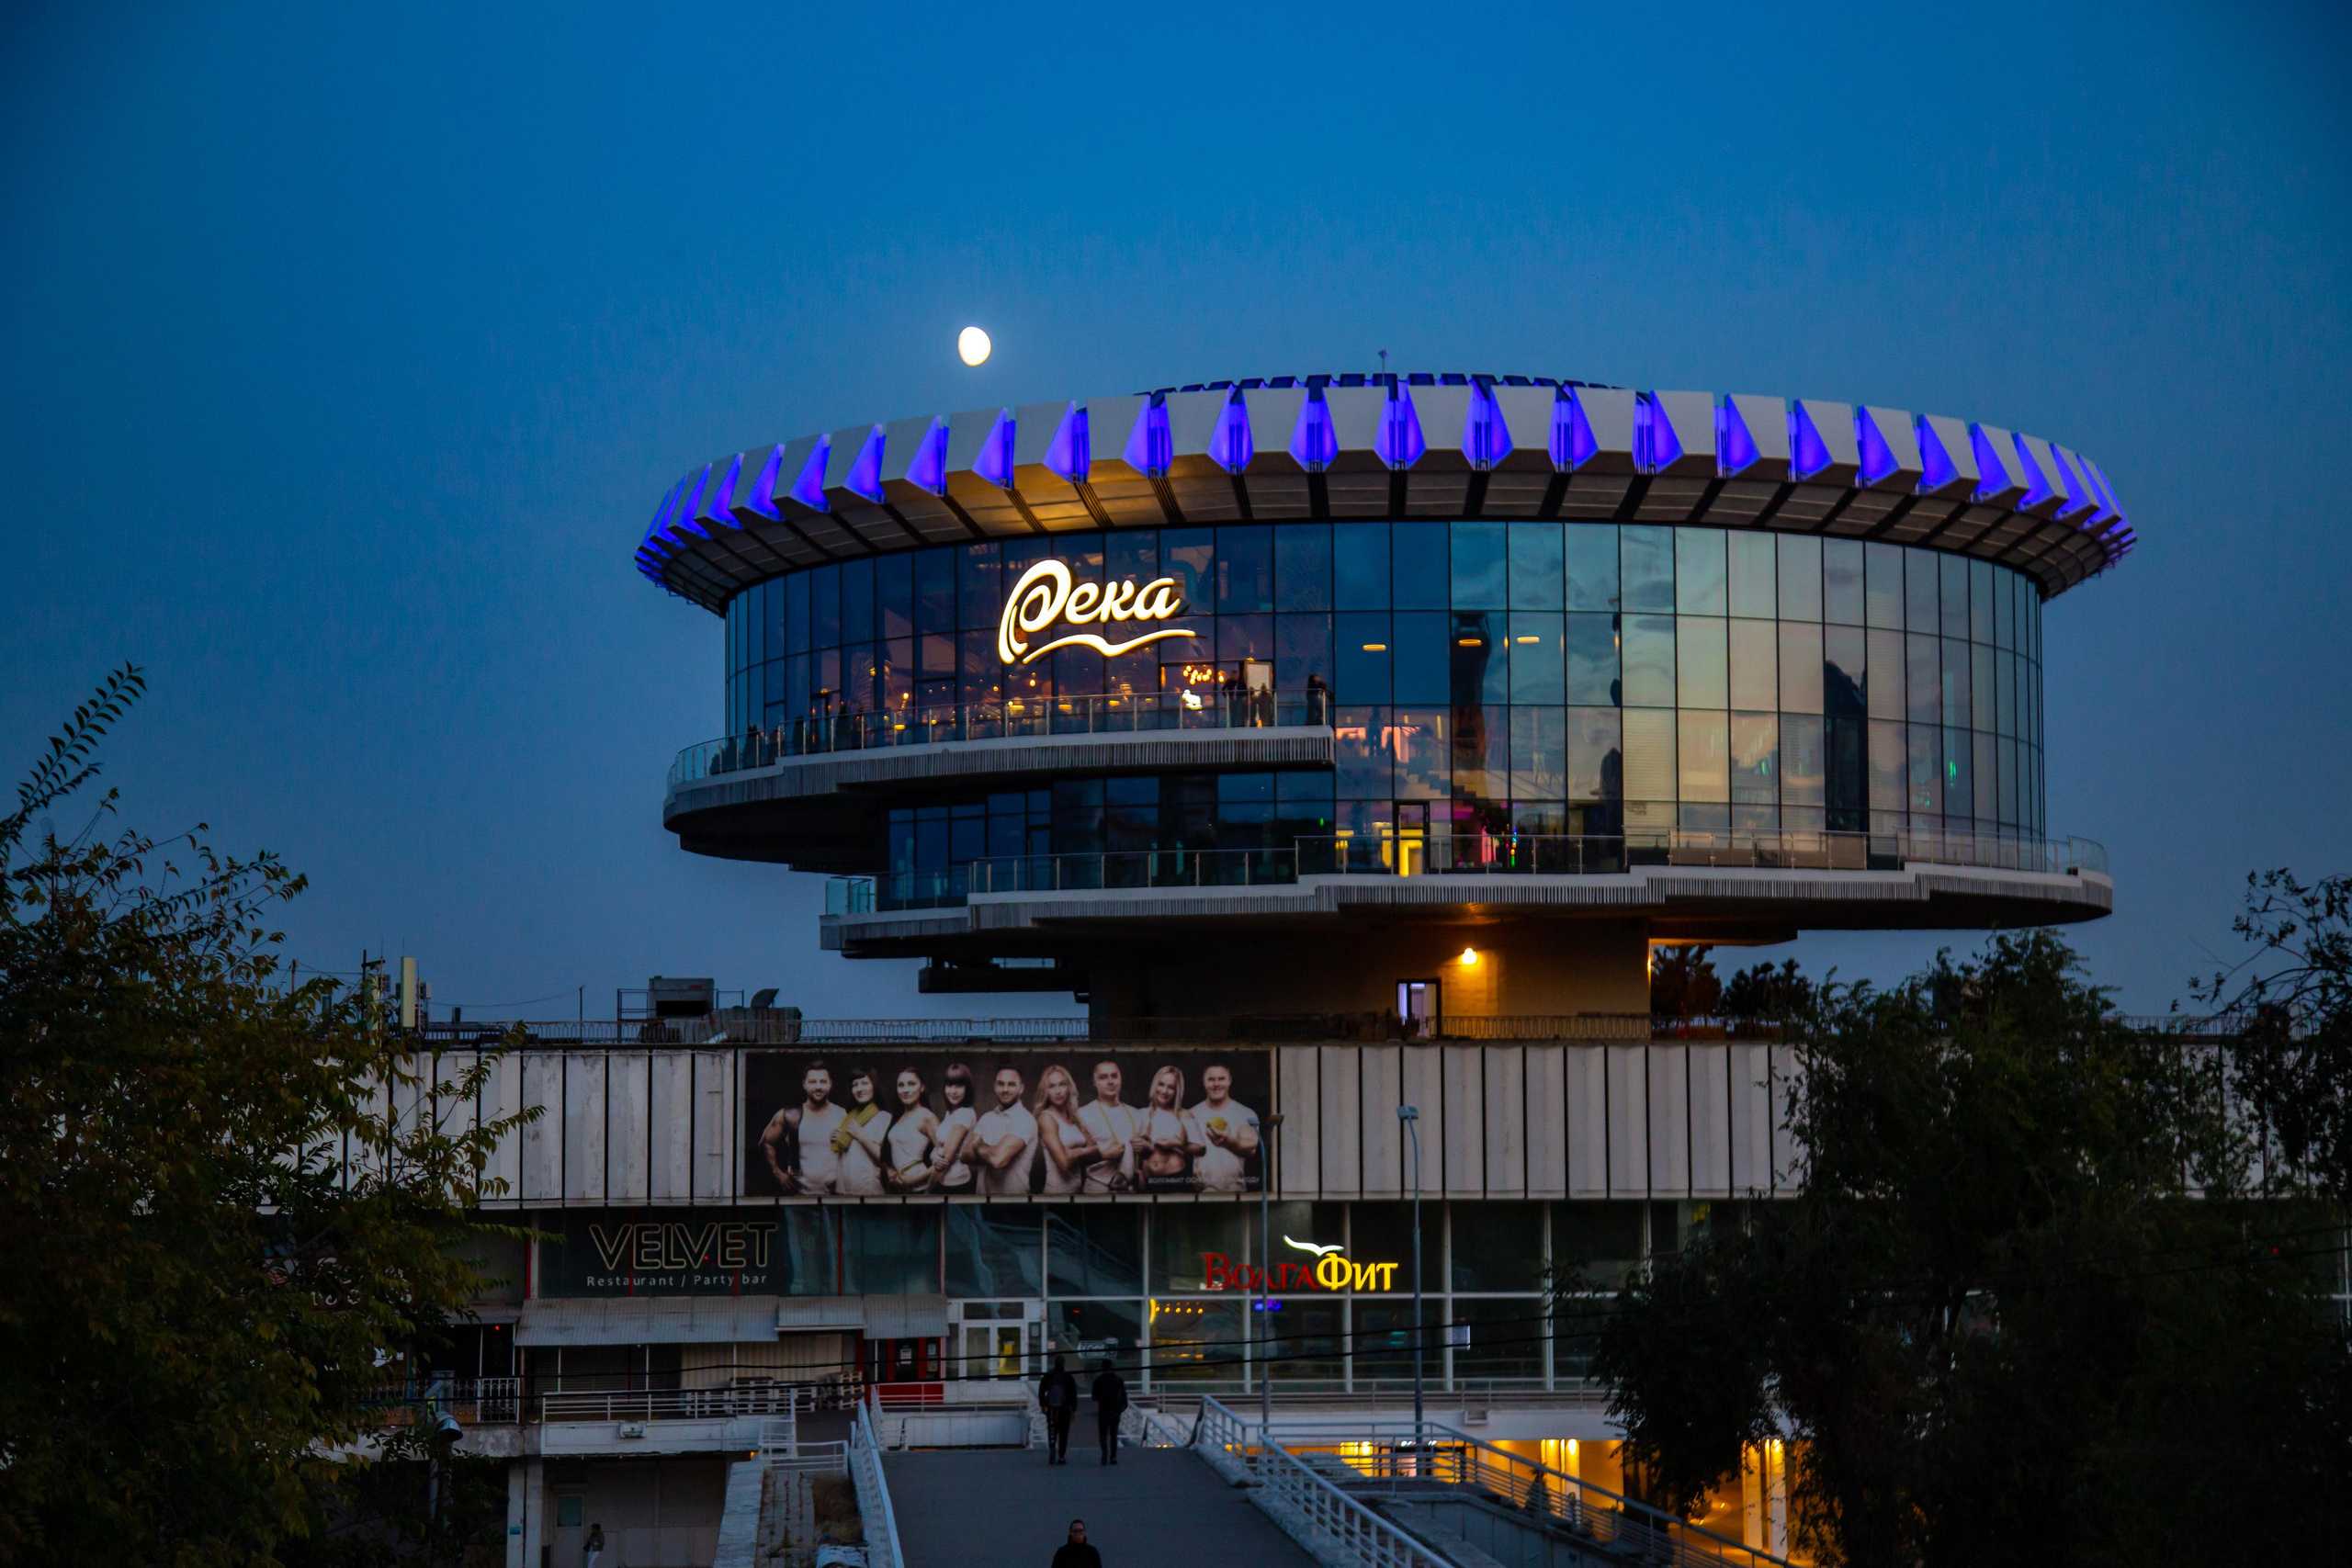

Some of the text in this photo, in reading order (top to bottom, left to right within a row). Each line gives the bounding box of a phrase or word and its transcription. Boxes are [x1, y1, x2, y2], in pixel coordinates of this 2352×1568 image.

[999, 559, 1182, 664] Река
[588, 1222, 779, 1271] VELVET
[586, 1275, 674, 1287] Restaurant
[694, 1275, 734, 1287] Party
[741, 1273, 767, 1284] bar
